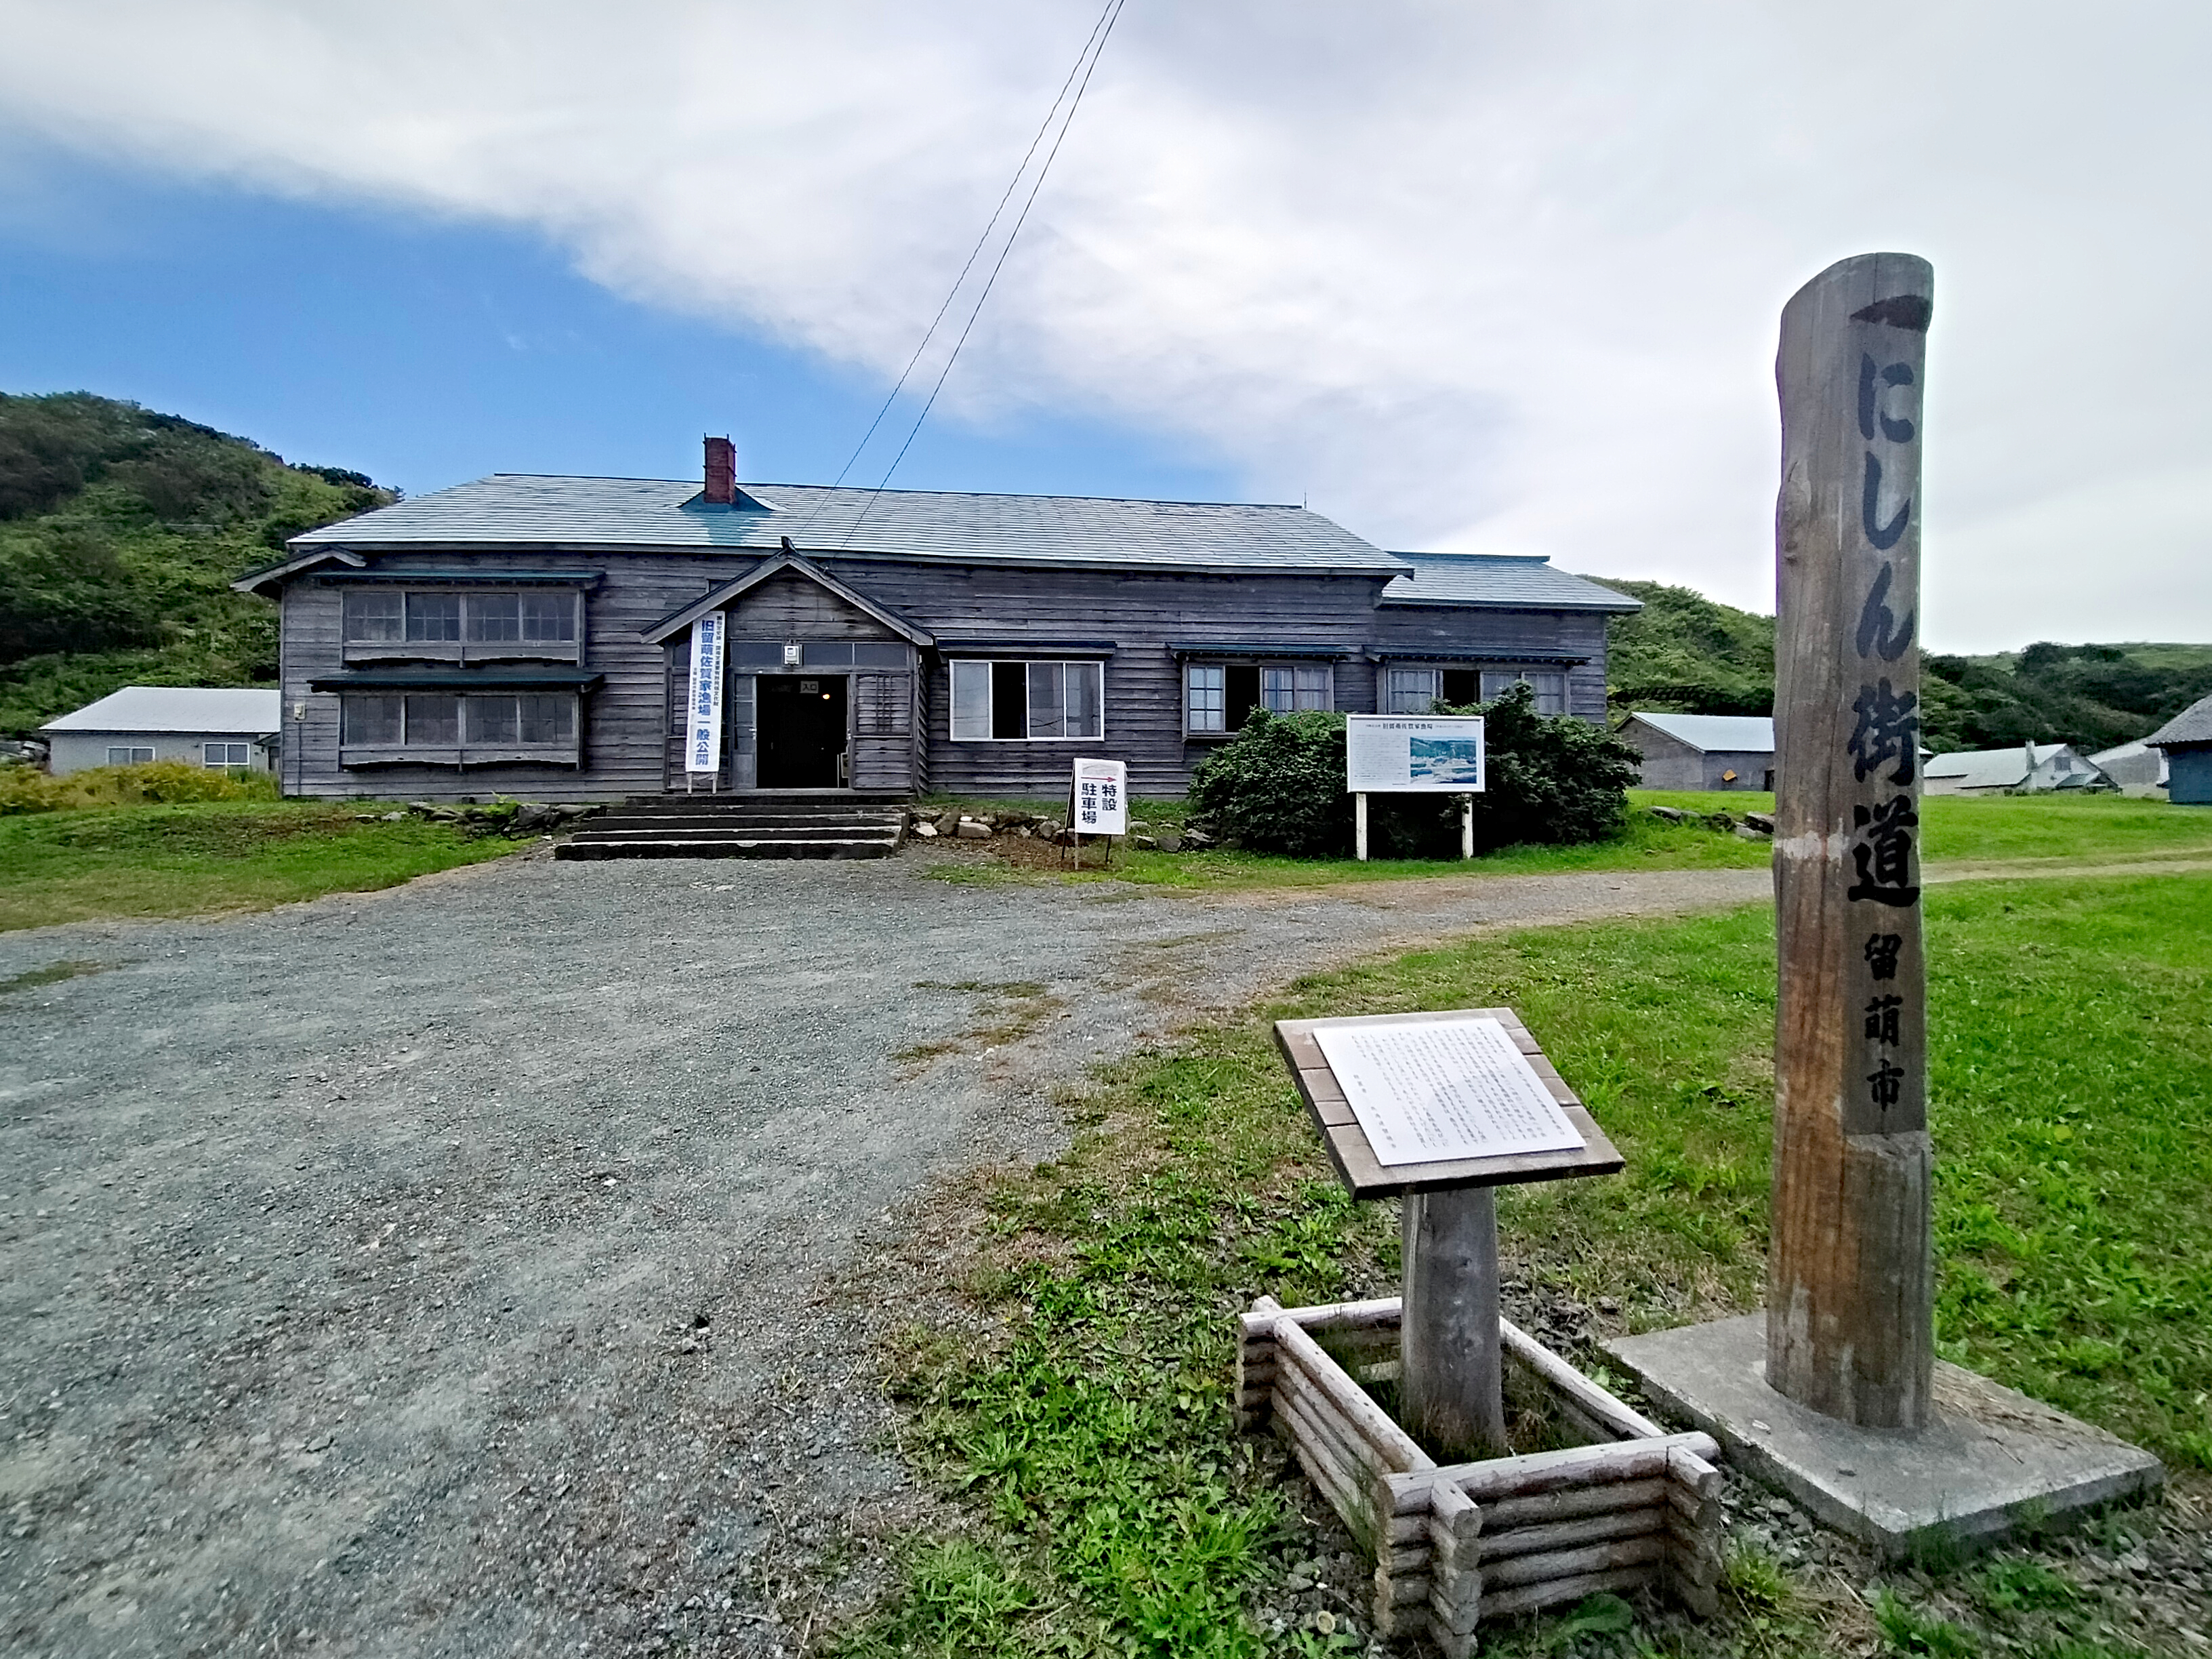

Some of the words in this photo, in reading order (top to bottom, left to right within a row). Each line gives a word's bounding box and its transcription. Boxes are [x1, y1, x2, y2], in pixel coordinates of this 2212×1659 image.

[1848, 352, 1921, 909] にしん街道
[802, 683, 817, 691] 入口
[1081, 783, 1097, 824] 駐車場
[1101, 783, 1118, 811] 特設
[1863, 932, 1904, 1113] 留萌市
